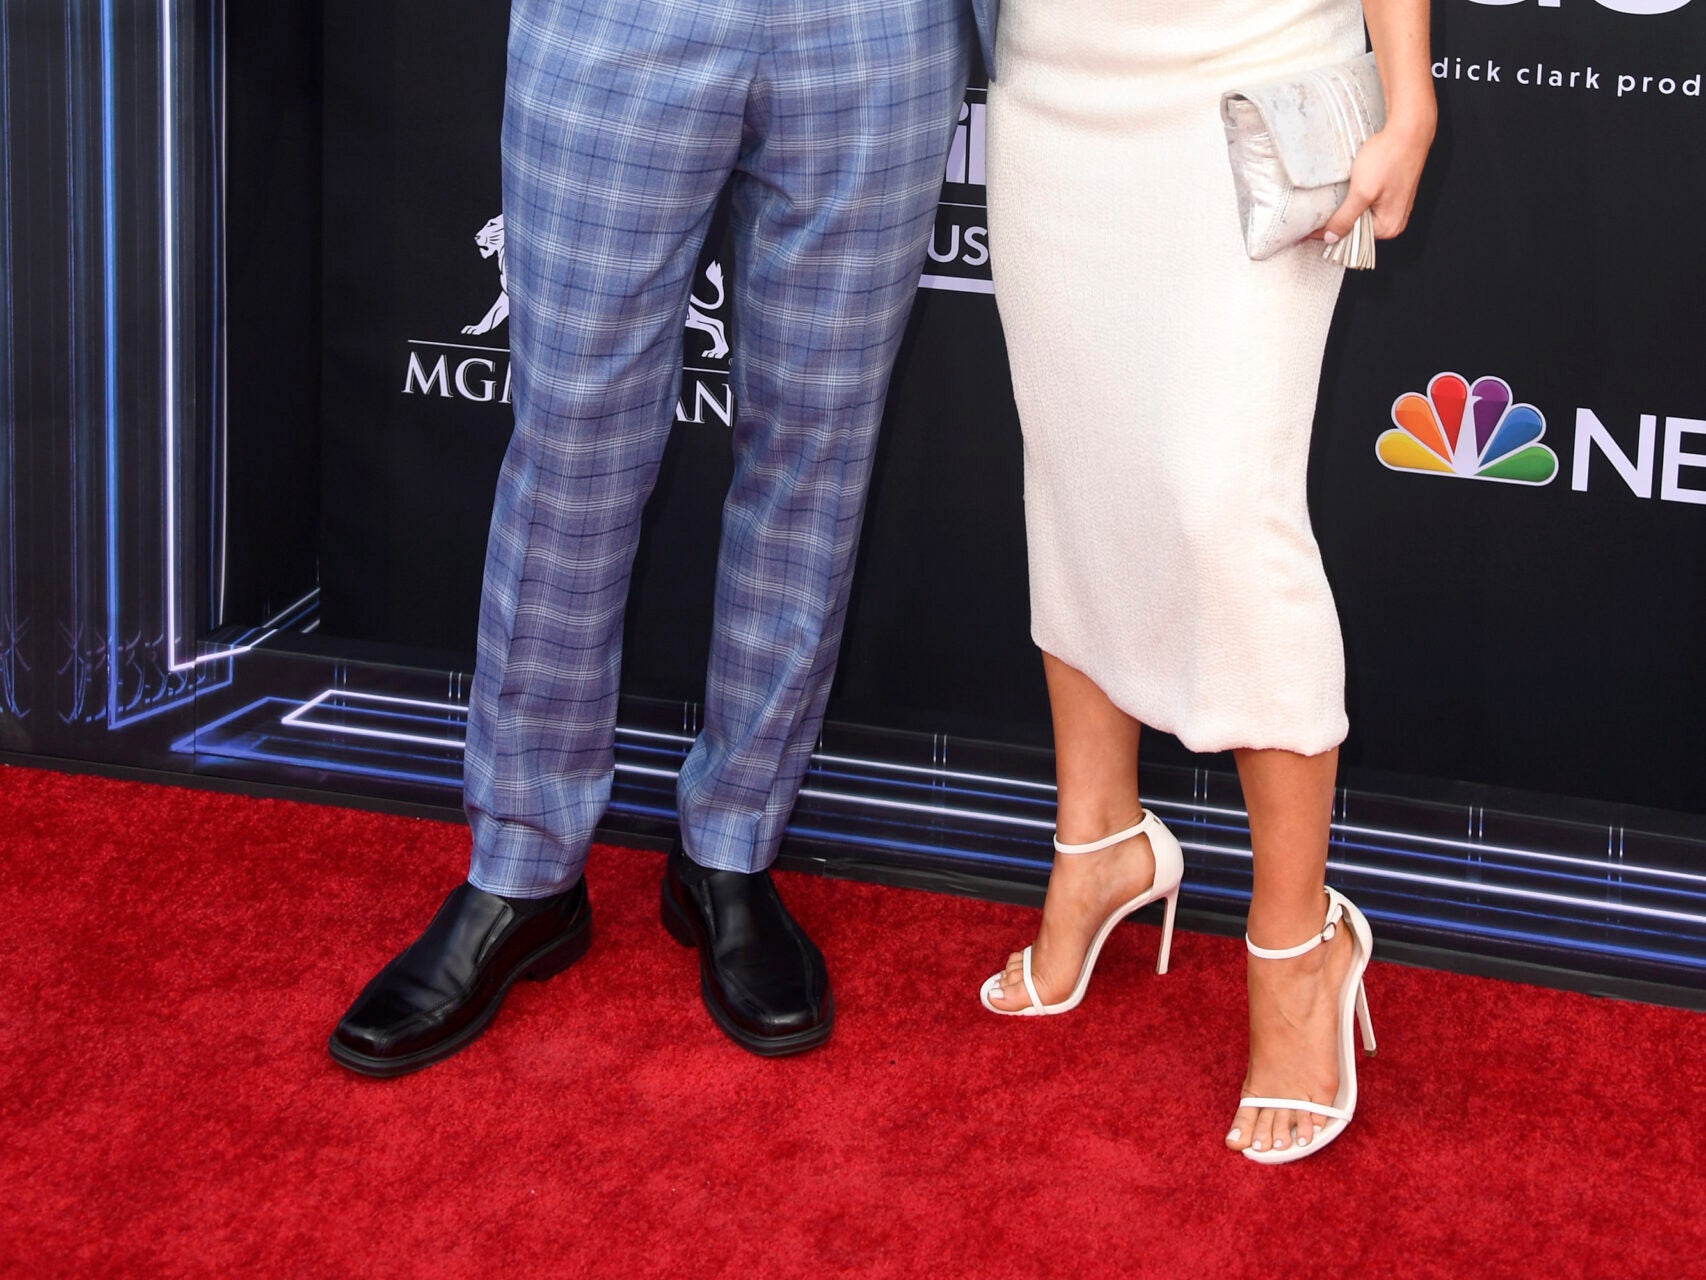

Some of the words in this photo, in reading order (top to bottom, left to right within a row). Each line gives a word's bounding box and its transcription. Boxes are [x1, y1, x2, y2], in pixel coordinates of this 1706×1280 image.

[1430, 57, 1501, 83] dick
[1516, 63, 1600, 89] clark
[1617, 74, 1702, 98] prod
